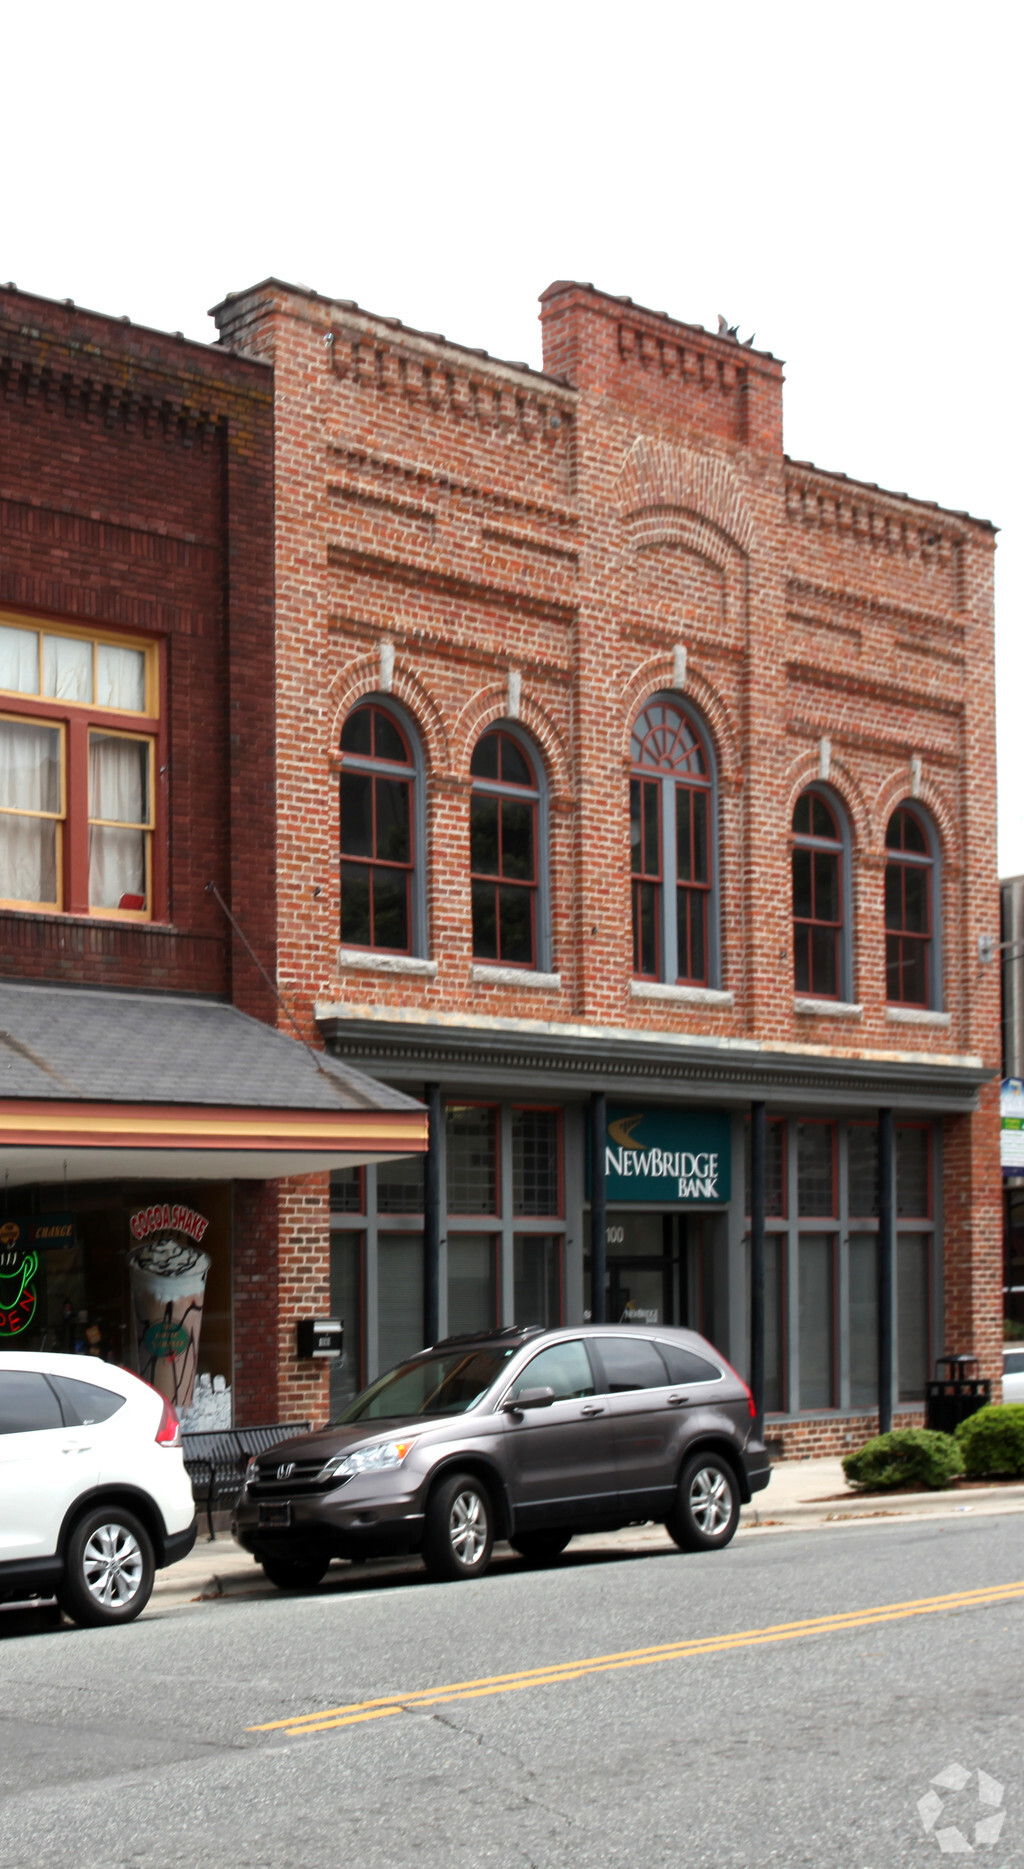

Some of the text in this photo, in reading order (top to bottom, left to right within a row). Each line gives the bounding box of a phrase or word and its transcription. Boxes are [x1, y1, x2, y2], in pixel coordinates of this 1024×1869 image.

[678, 1178, 719, 1198] BANK
[130, 1204, 210, 1243] COCOA SHAKE
[606, 1226, 624, 1243] 100
